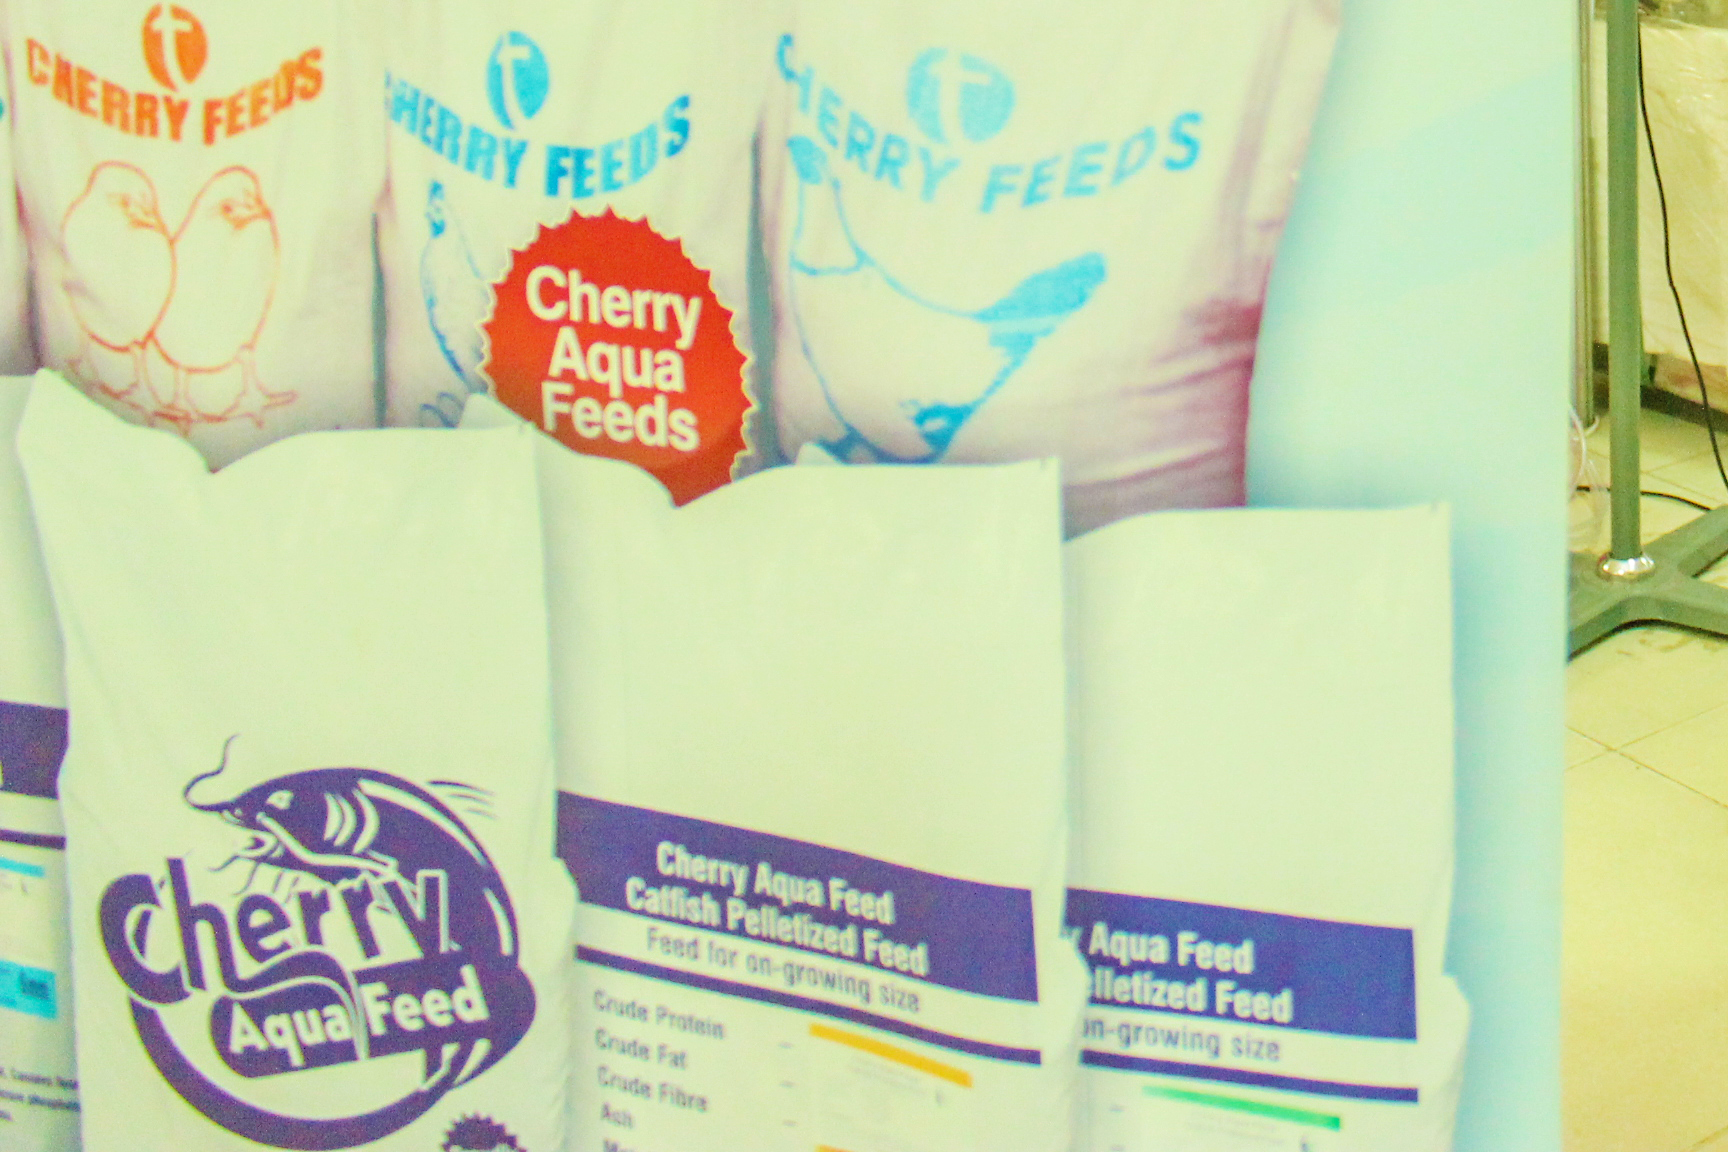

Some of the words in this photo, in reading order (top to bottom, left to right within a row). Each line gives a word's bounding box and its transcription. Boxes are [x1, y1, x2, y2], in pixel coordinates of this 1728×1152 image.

[26, 36, 191, 143] CHERRY
[203, 46, 324, 147] FEEDS
[385, 69, 529, 189] HERRY
[544, 94, 692, 199] FEEDS
[979, 111, 1204, 215] FEEDS
[526, 265, 702, 350] Cherry
[548, 325, 686, 399] Aqua
[541, 380, 700, 451] Feeds
[656, 840, 750, 897] Cherry
[753, 861, 826, 907] Aqua
[828, 877, 896, 926] Feed
[98, 855, 448, 1004] Cherry
[625, 876, 722, 927] Catfish
[726, 898, 859, 958] Pelletized
[862, 928, 930, 977] Feed
[1088, 921, 1170, 966] Aqua
[1176, 931, 1256, 975] Feed
[647, 925, 700, 962] Feed
[708, 940, 738, 969] for
[746, 952, 871, 1006] on-growing
[879, 983, 920, 1014] size
[1215, 979, 1294, 1024] Feed
[229, 1001, 353, 1067] Aqua
[360, 963, 491, 1036] Feed
[594, 988, 649, 1023] Crude
[656, 1005, 725, 1040] Protein
[595, 1026, 650, 1061] Crude
[657, 1043, 688, 1070] Fat
[1230, 1035, 1281, 1062] size
[598, 1065, 652, 1099] Crude
